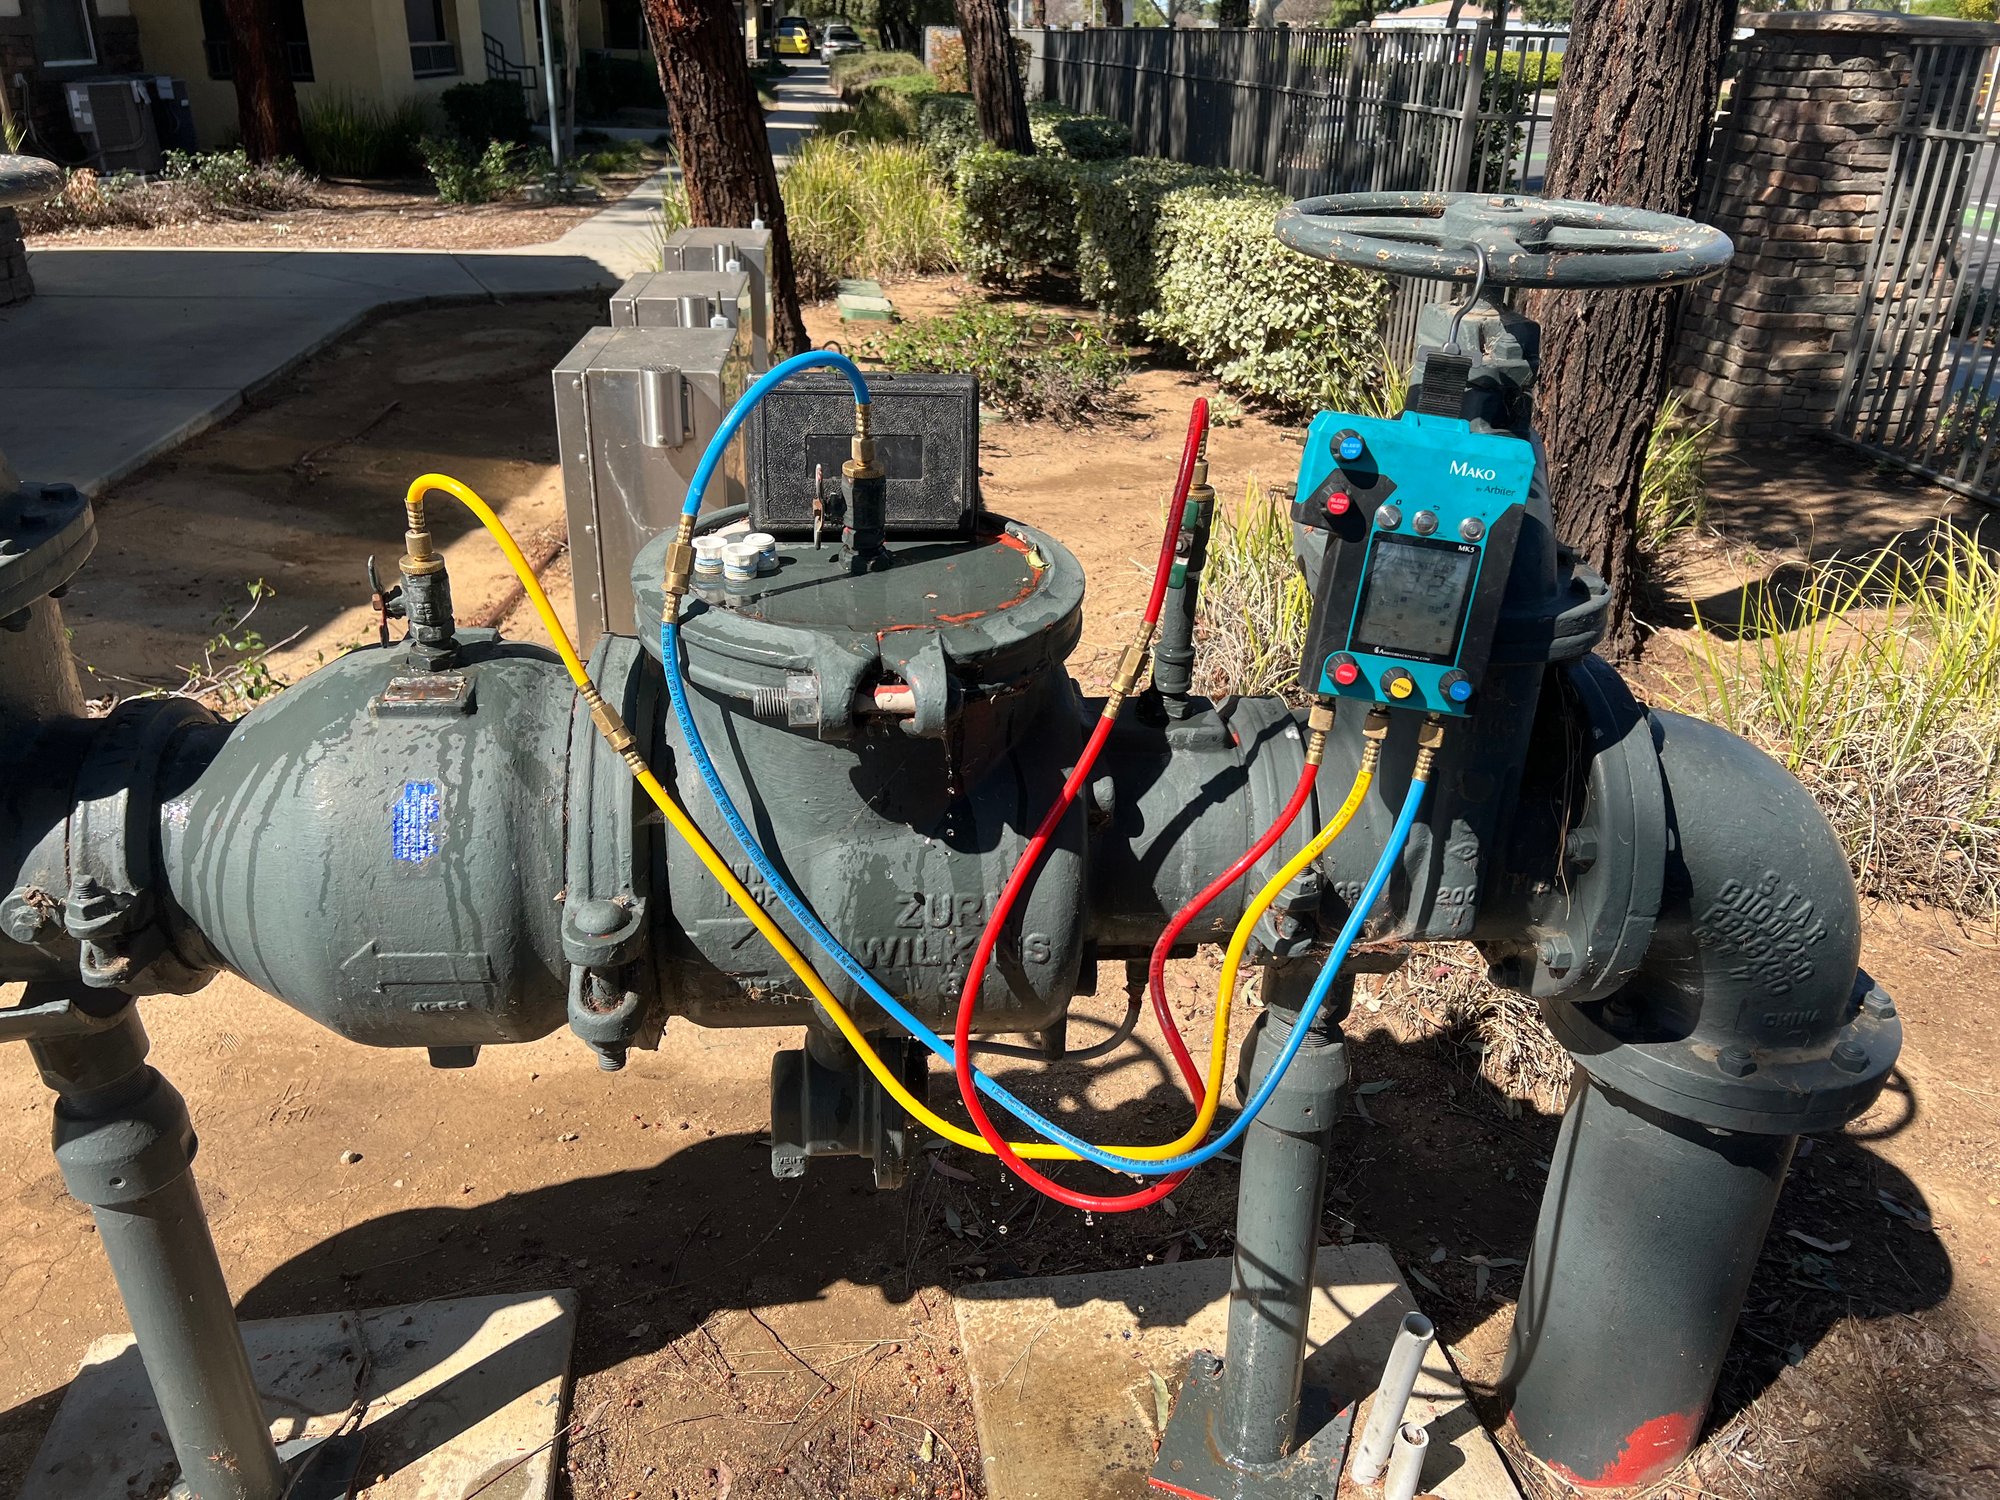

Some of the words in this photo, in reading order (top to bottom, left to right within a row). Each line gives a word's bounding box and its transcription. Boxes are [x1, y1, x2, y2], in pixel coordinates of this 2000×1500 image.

[1484, 485, 1516, 497] Arbiter
[1330, 497, 1348, 505] BLEED
[1393, 682, 1410, 694] BYPASS
[1757, 870, 1827, 947] STAR
[854, 932, 1052, 969] WILKNS
[777, 1156, 804, 1164] VENT
